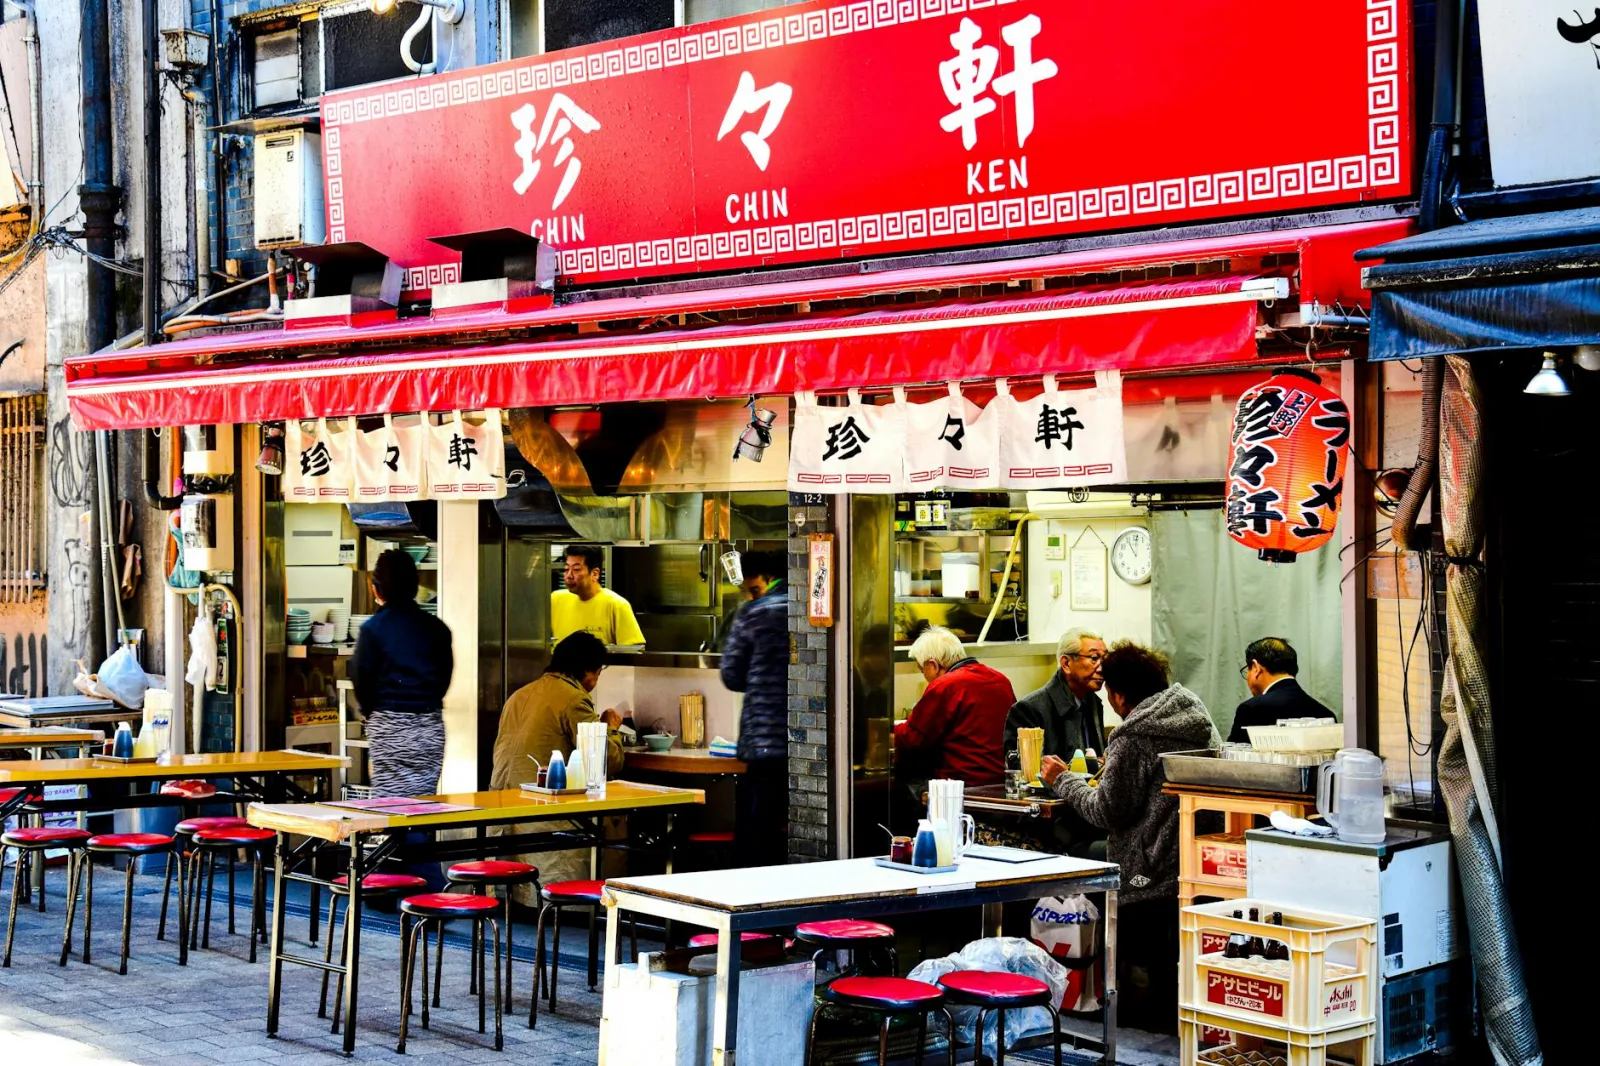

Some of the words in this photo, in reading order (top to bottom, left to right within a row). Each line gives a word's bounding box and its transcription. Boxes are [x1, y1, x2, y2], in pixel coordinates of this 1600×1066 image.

[530, 213, 586, 244] CHIN
[725, 187, 789, 224] CHIN
[967, 155, 1029, 195] KEN
[1271, 391, 1310, 434] 上野
[1292, 399, 1351, 538] ラーメン
[804, 494, 822, 503] 12-2
[1208, 972, 1282, 1001] アサヒビール
[1329, 984, 1353, 1003] Asahi
[1324, 1005, 1331, 1017] 中
[1349, 1000, 1356, 1012] 20
